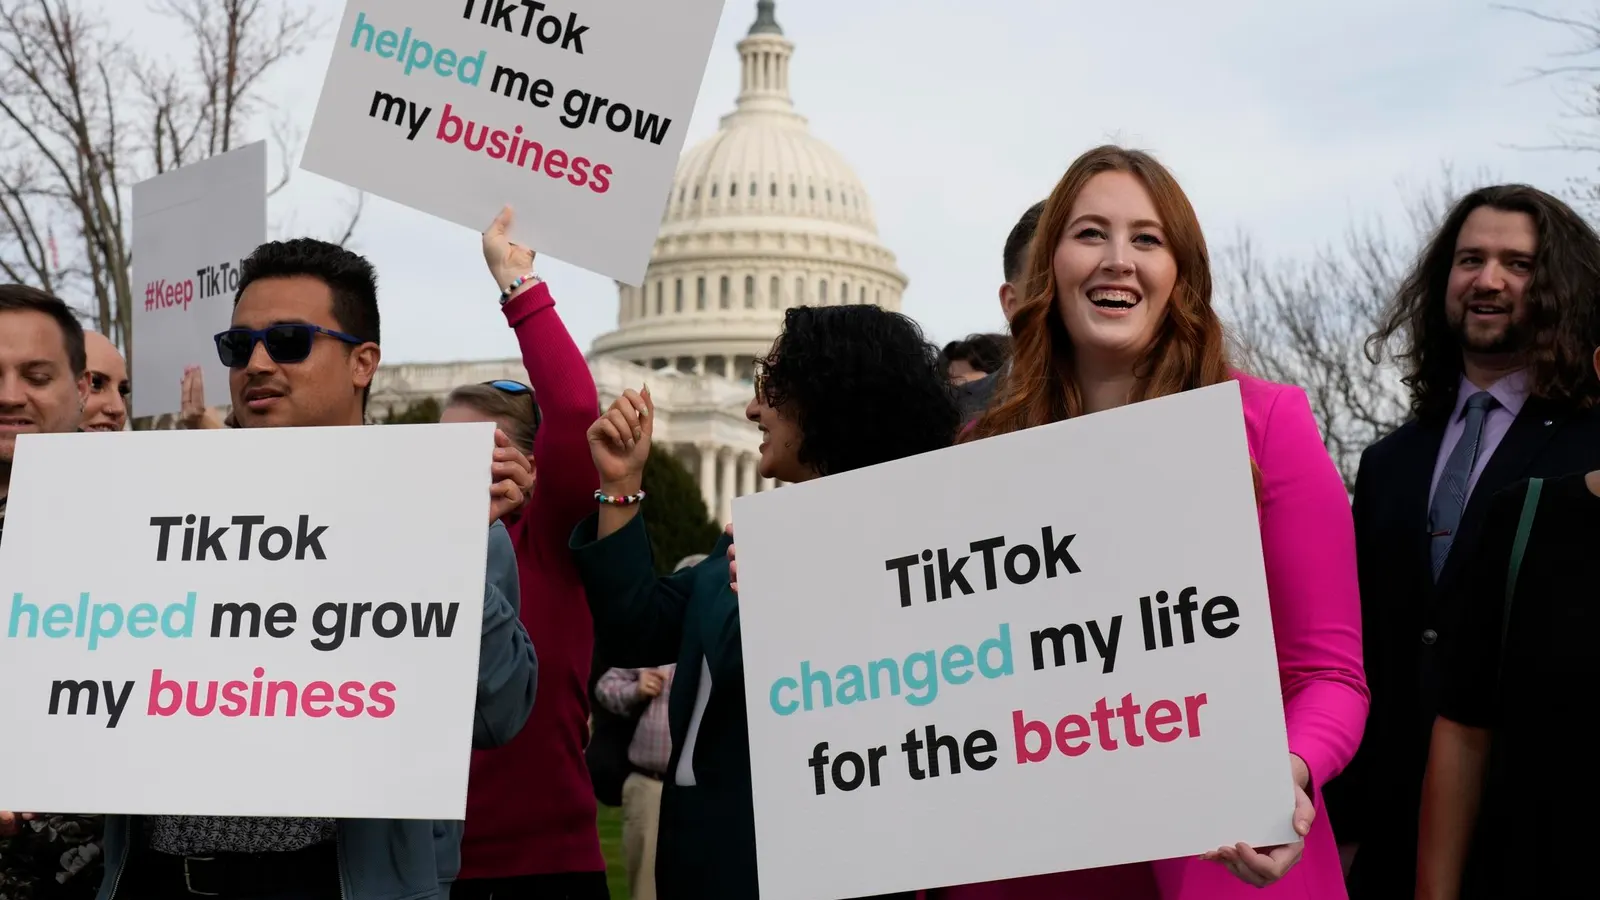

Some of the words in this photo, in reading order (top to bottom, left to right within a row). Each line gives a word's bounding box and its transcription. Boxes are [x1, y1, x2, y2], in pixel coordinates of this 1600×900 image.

[351, 13, 487, 86] helped
[490, 65, 555, 109] me
[559, 89, 673, 146] grow
[369, 90, 433, 141] my
[436, 103, 614, 194] business
[145, 279, 194, 312] #Keep
[197, 259, 242, 299] TikTo
[150, 514, 329, 561] TikTok
[885, 525, 1082, 608] TikTok
[8, 592, 196, 651] helped
[210, 602, 298, 638] me
[310, 602, 460, 652] grow
[770, 623, 1014, 716] changed
[1030, 615, 1123, 675] my
[1139, 586, 1240, 652] life
[48, 680, 135, 729] my
[147, 667, 397, 719] business
[808, 742, 888, 796] for
[901, 724, 998, 780] the
[1012, 693, 1208, 765] better
